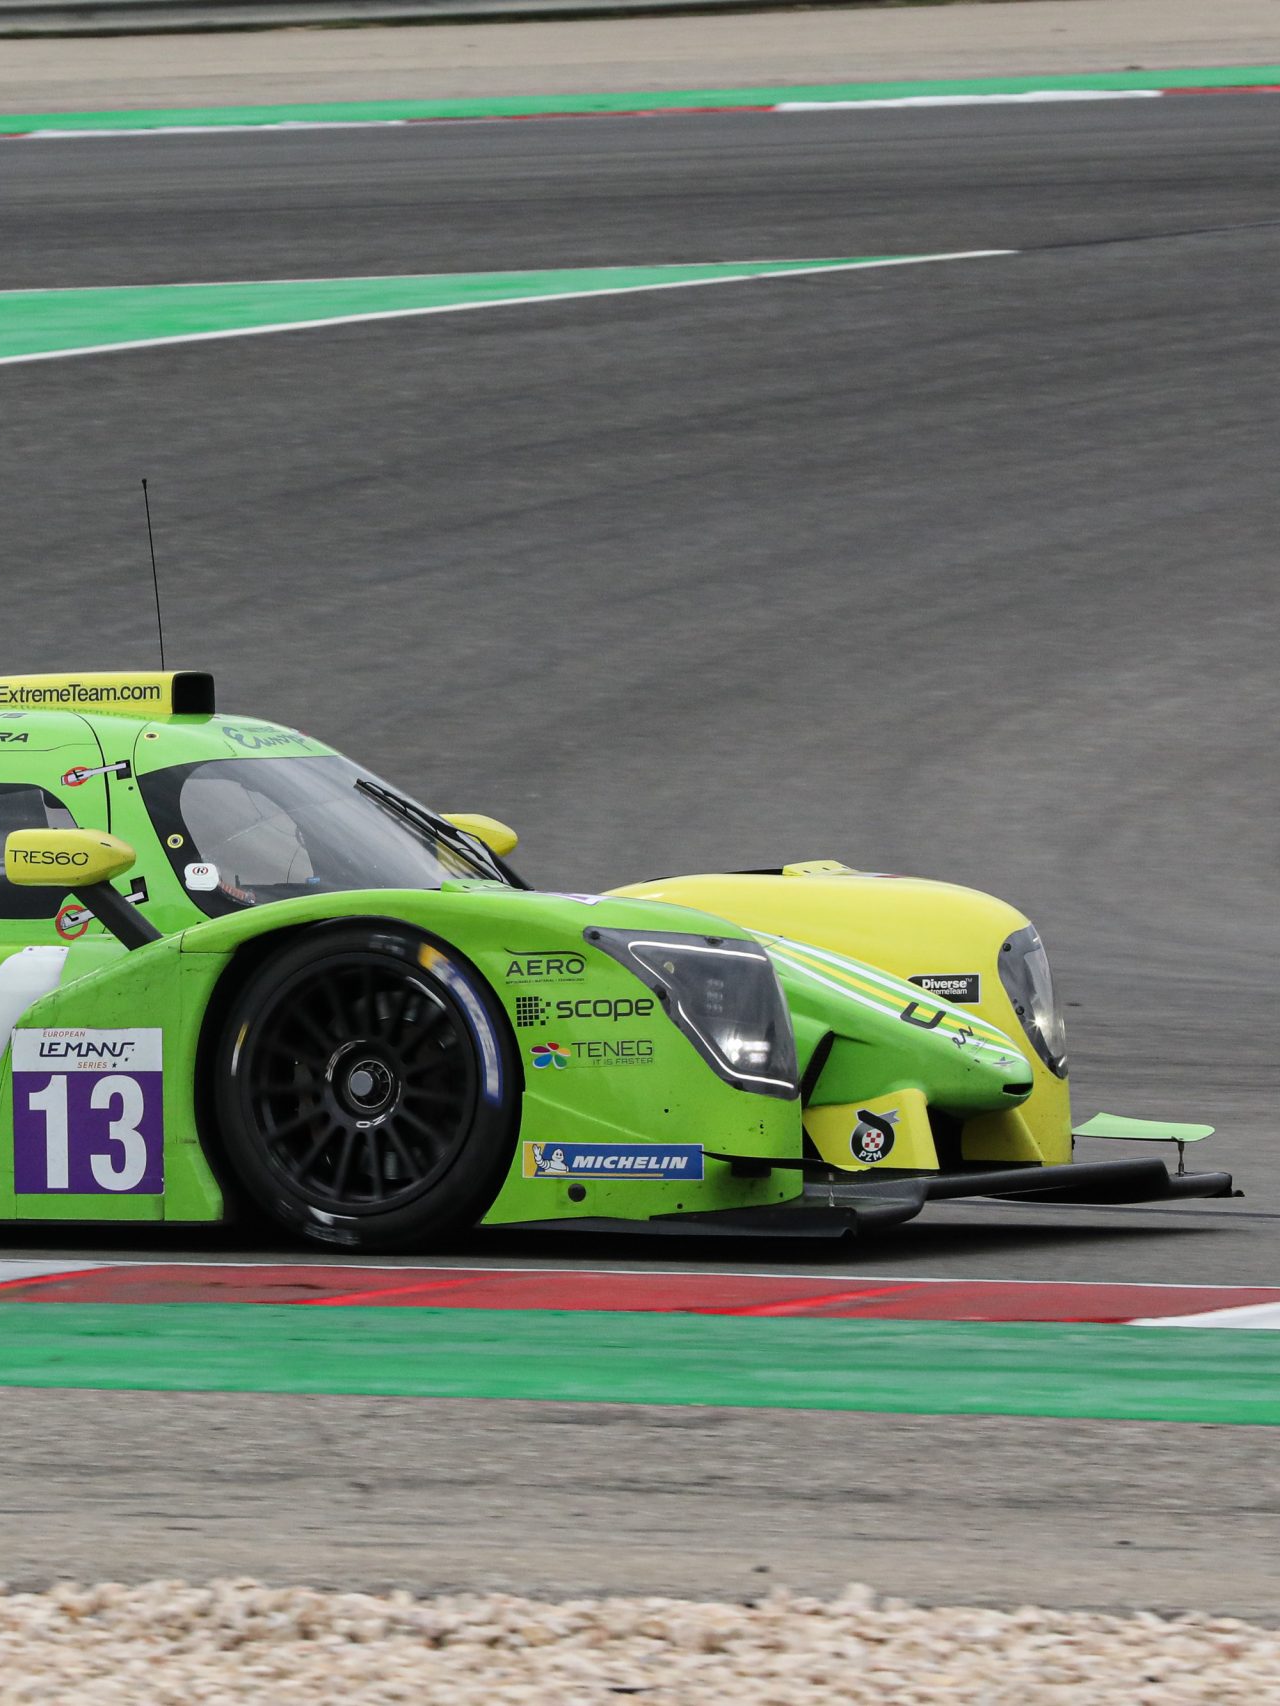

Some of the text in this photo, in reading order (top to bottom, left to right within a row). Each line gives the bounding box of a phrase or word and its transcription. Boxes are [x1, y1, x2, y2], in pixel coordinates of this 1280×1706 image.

[9, 849, 89, 866] TRES60
[505, 958, 585, 977] AERO
[556, 998, 654, 1021] scope
[571, 1040, 653, 1058] TENEG
[77, 1061, 108, 1069] SERIES
[28, 1074, 148, 1192] 13
[571, 1155, 689, 1170] MICHELIN
[858, 1150, 883, 1162] PZM
